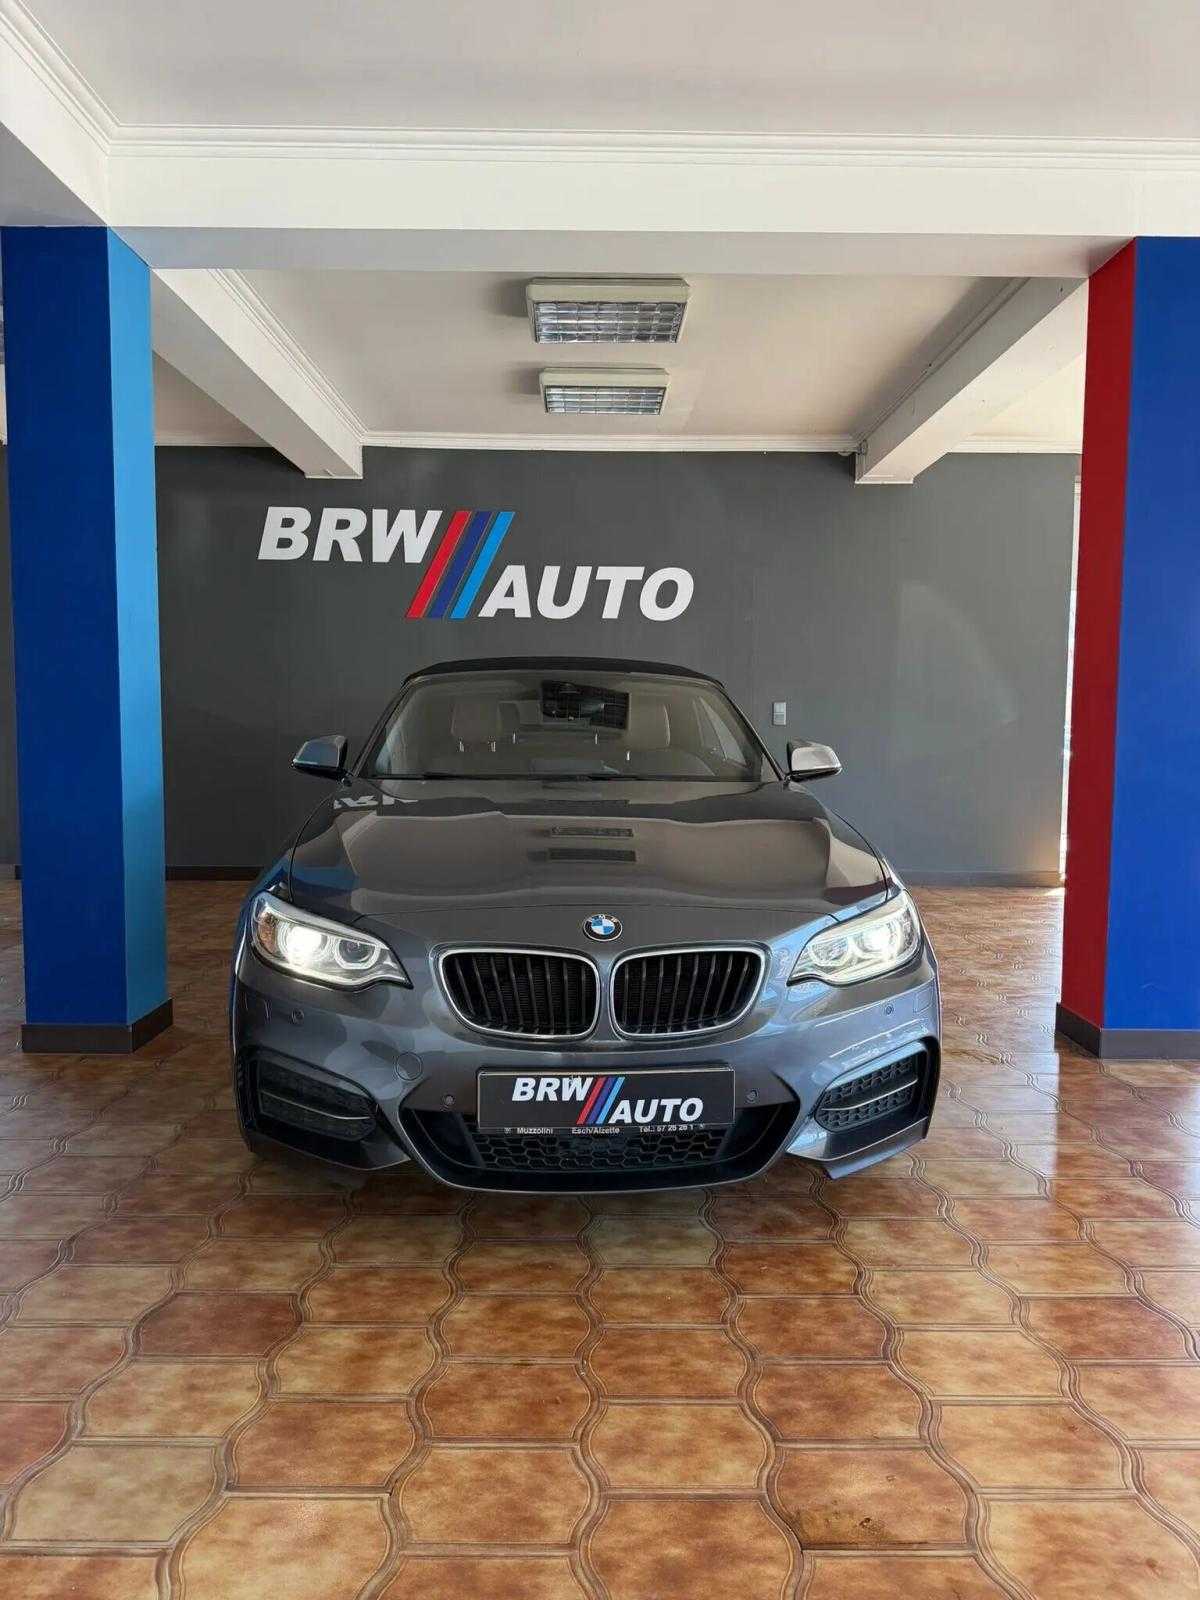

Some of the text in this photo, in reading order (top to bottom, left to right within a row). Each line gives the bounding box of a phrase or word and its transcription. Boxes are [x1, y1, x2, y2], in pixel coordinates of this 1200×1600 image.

[257, 506, 443, 564] BRW
[478, 565, 695, 622] AUTO
[511, 1077, 594, 1102] BRW
[608, 1097, 704, 1124] AUTO
[516, 1127, 553, 1135] Muzzolini
